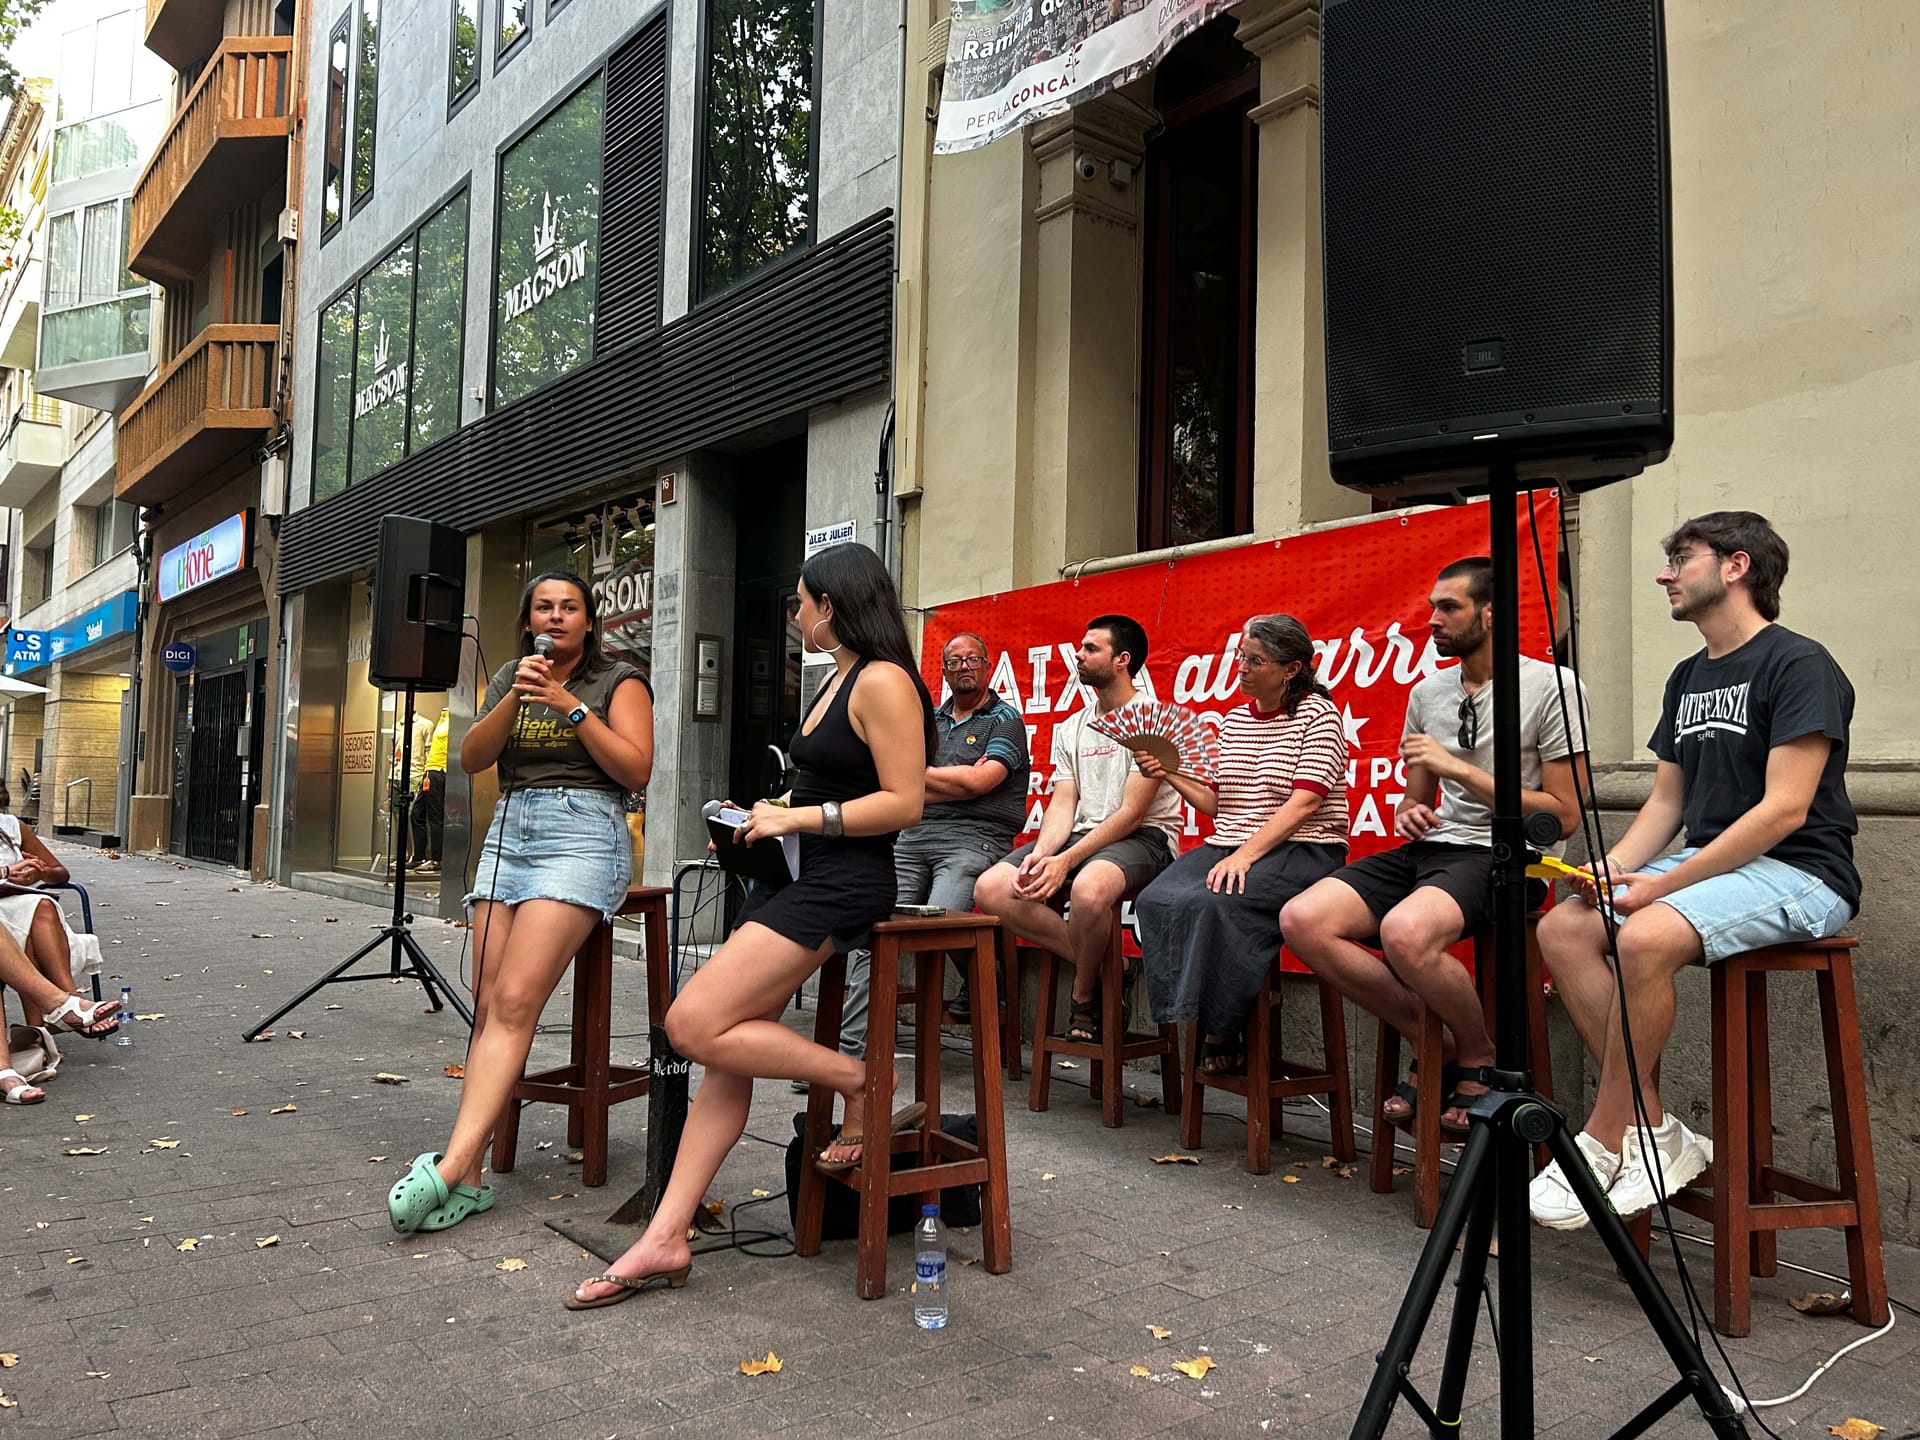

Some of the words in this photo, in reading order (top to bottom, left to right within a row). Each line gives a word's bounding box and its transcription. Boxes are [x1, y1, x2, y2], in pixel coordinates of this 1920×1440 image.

[963, 6, 1033, 61] Rambla
[504, 240, 588, 323] MACSON
[355, 362, 408, 419] MACSON
[662, 478, 670, 490] 16
[809, 531, 827, 545] ALEX
[591, 571, 652, 618] CSON
[13, 650, 40, 661] ATM
[165, 650, 190, 660] DIGI
[521, 720, 557, 730] SOM
[519, 728, 577, 739] REFUG
[345, 736, 373, 752] SEGONES
[344, 754, 372, 770] REBAIXES
